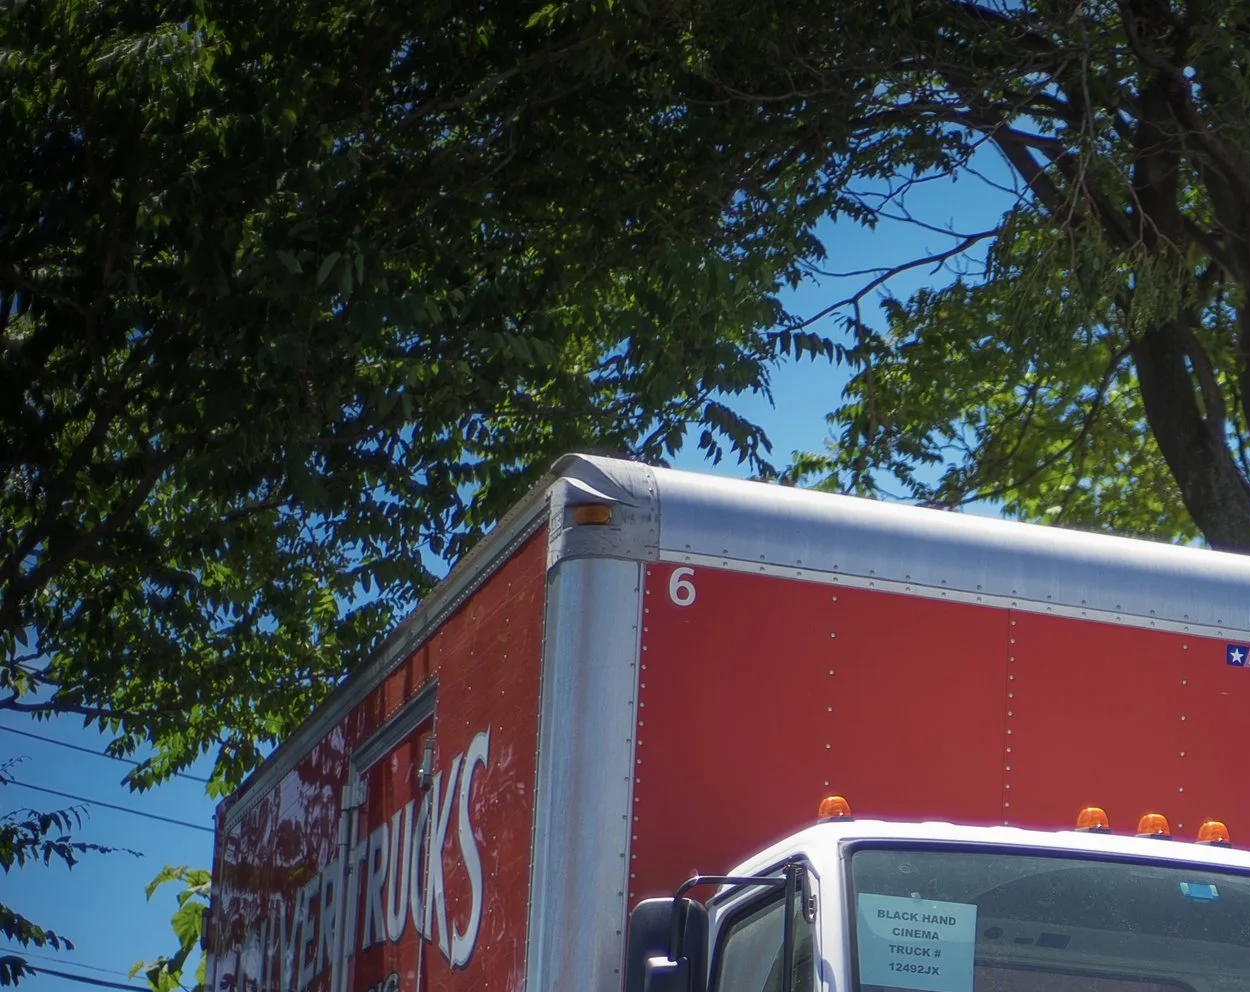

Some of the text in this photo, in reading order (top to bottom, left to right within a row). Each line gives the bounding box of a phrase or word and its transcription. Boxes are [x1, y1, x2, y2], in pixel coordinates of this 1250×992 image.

[669, 566, 696, 606] 6
[877, 909, 956, 926] BLACK HAND
[892, 927, 940, 940] CINEMA
[888, 944, 941, 959] TRUCK #
[888, 962, 940, 976] 12492JX
